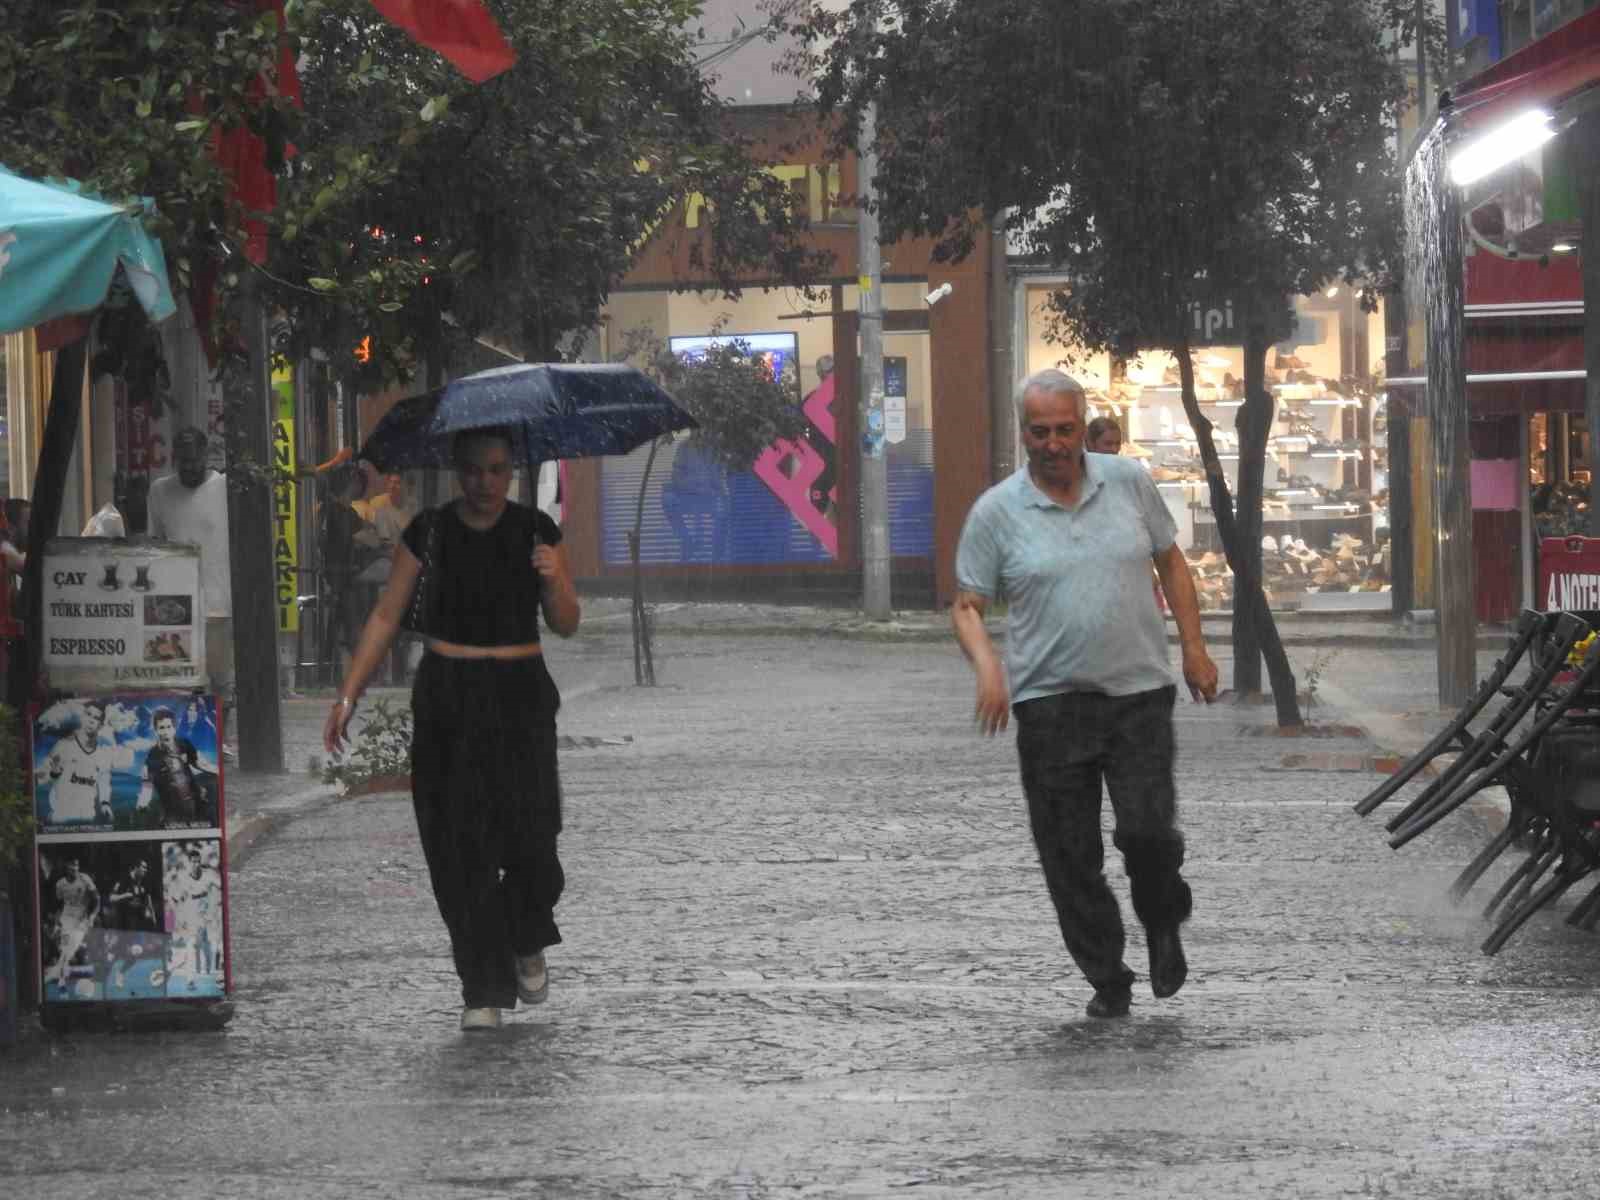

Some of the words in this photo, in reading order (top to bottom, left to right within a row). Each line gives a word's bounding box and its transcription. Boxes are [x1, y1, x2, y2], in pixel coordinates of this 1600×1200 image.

[53, 572, 87, 589] ÇAY
[51, 598, 82, 617] TÜRK
[84, 599, 135, 618] KAHVESİ
[50, 638, 126, 657] ESPRESSO
